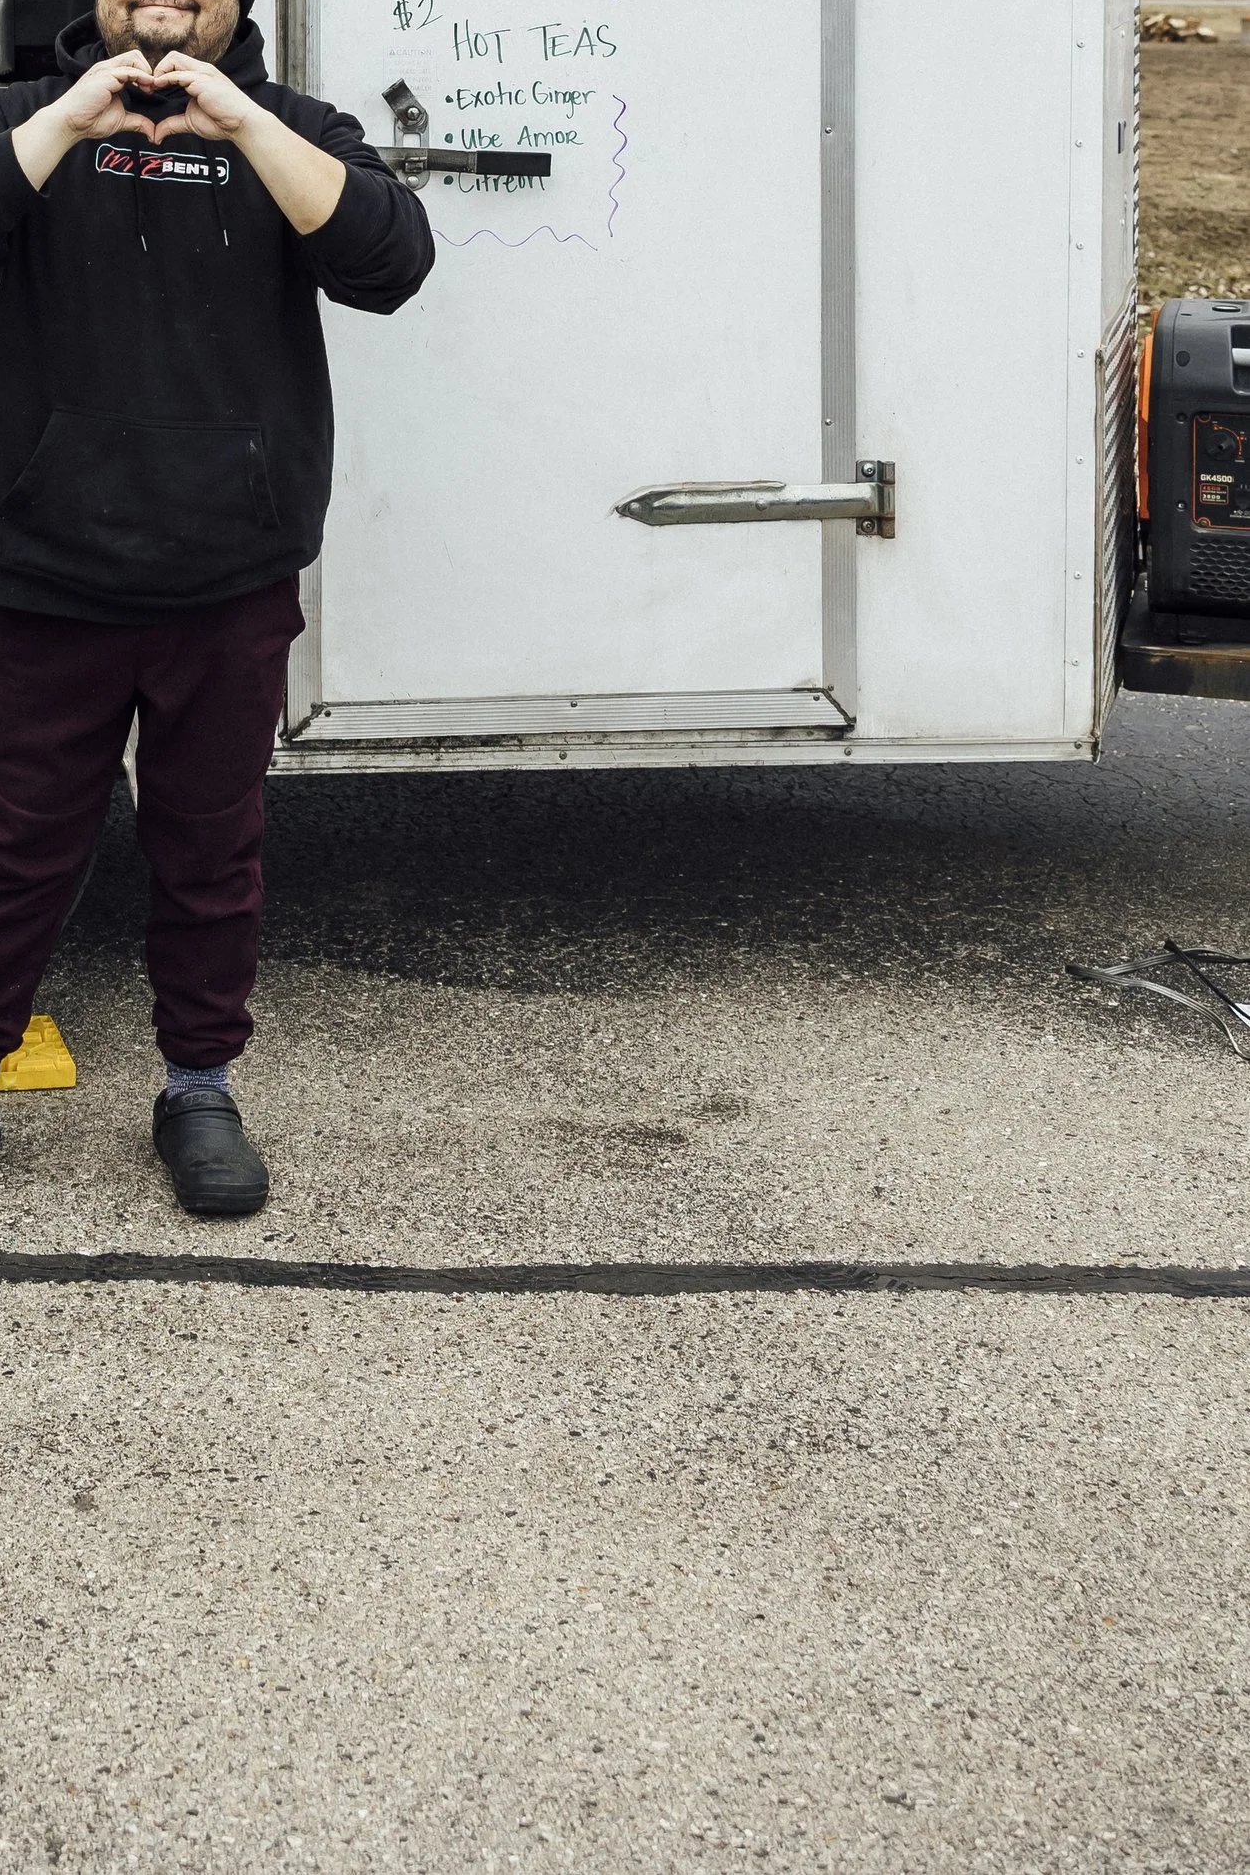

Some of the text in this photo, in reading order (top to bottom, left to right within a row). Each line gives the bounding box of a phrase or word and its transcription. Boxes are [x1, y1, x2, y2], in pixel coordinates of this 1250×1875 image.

[453, 21, 618, 64] HOT TEAS
[457, 81, 596, 119] Exotic Ginger
[462, 128, 503, 150] Ube
